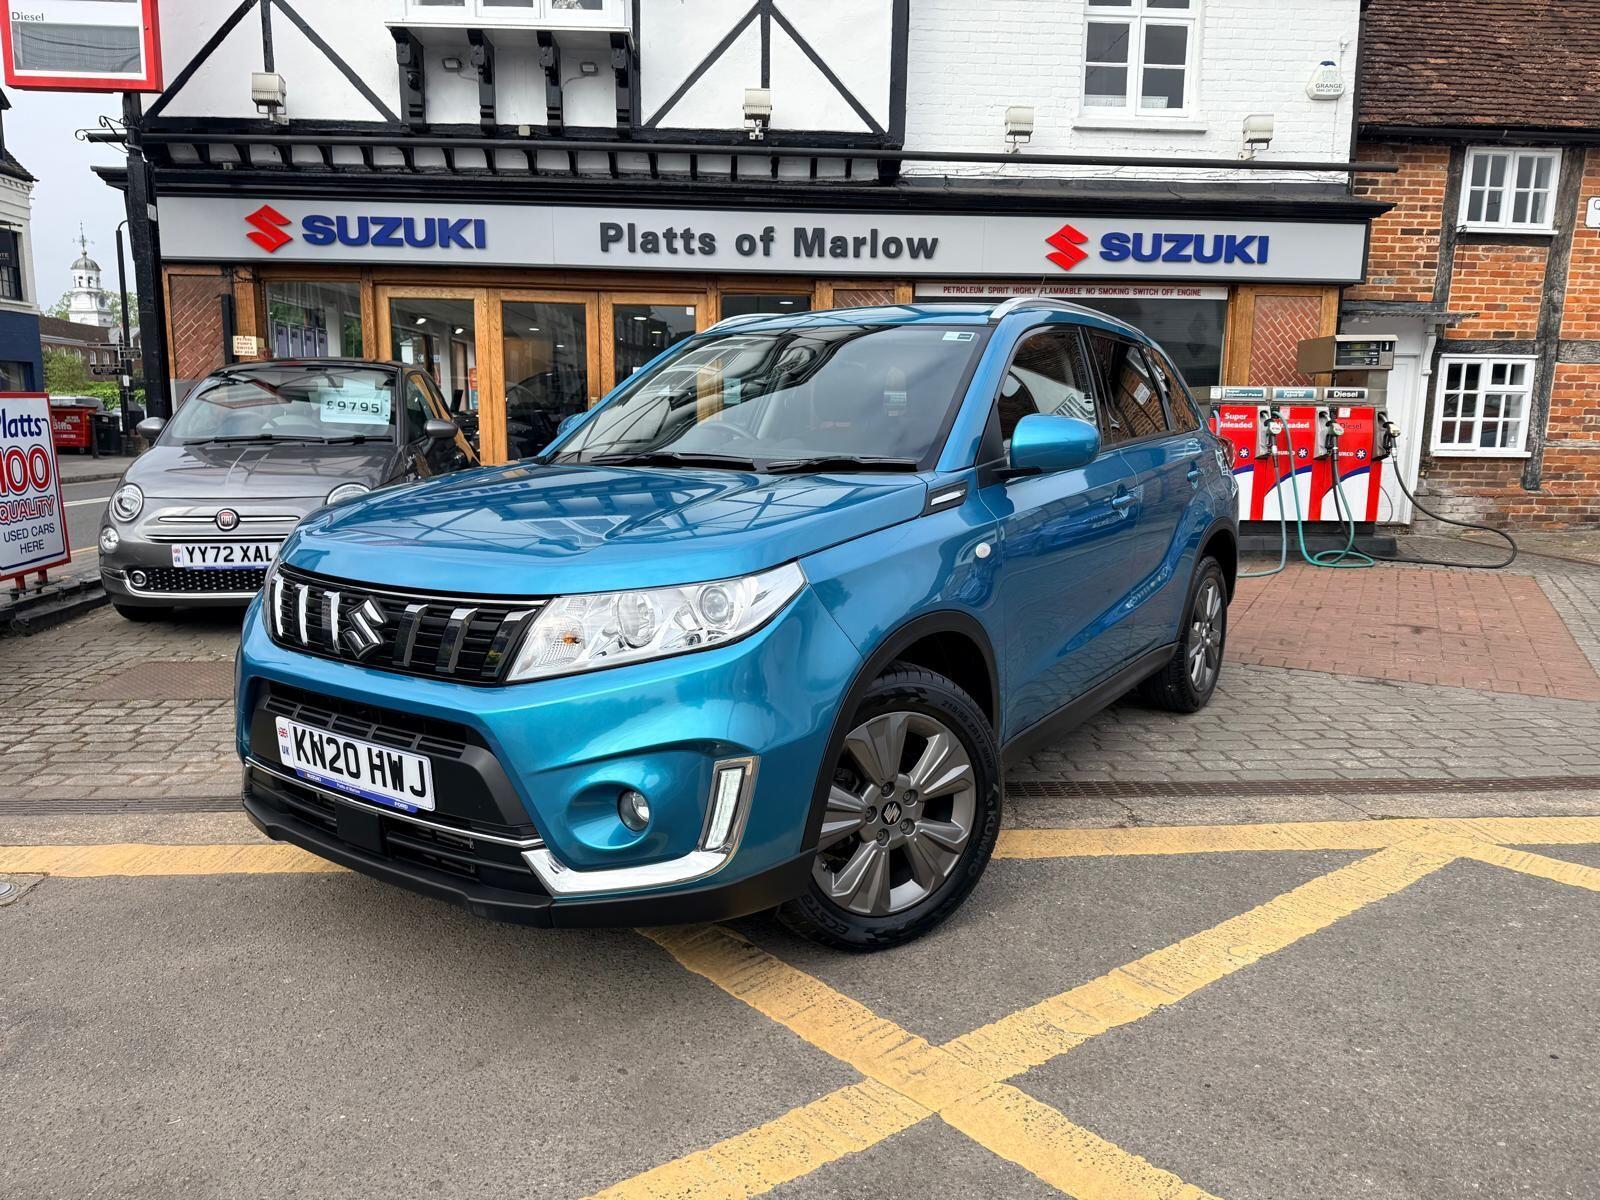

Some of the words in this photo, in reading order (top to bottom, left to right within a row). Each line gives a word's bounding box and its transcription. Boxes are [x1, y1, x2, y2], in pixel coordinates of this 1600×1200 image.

[12, 11, 45, 22] Diesel
[302, 214, 486, 249] SUZUKI
[599, 222, 716, 256] Platts
[735, 226, 775, 257] of
[793, 227, 939, 259] Marlow
[1100, 231, 1270, 265] SUZUKI
[943, 285, 984, 294] PETROLEUM
[988, 286, 1009, 295] SPIRIT
[1013, 286, 1036, 295] HIGHLY
[1040, 286, 1082, 295] FLAMMABLE
[1086, 287, 1095, 295] NO
[1098, 287, 1130, 296] SMOKING
[1133, 288, 1159, 296] SWITCH
[1162, 288, 1174, 296] OFF
[1177, 289, 1201, 297] ENGINE
[1333, 390, 1359, 398] Diesel
[326, 400, 380, 414] £9795
[0, 407, 42, 438] latts
[1224, 412, 1248, 421] Super
[0, 496, 55, 526] QUALITY
[220, 515, 233, 525] FIAT
[3, 527, 29, 543] USED
[31, 522, 55, 538] CARS
[20, 540, 45, 554] HERE
[185, 546, 235, 563] YY72
[240, 545, 273, 562] XAL
[281, 744, 290, 756] UK
[293, 726, 361, 779] KN20
[367, 747, 427, 798] HWJ
[394, 801, 409, 811] FORD
